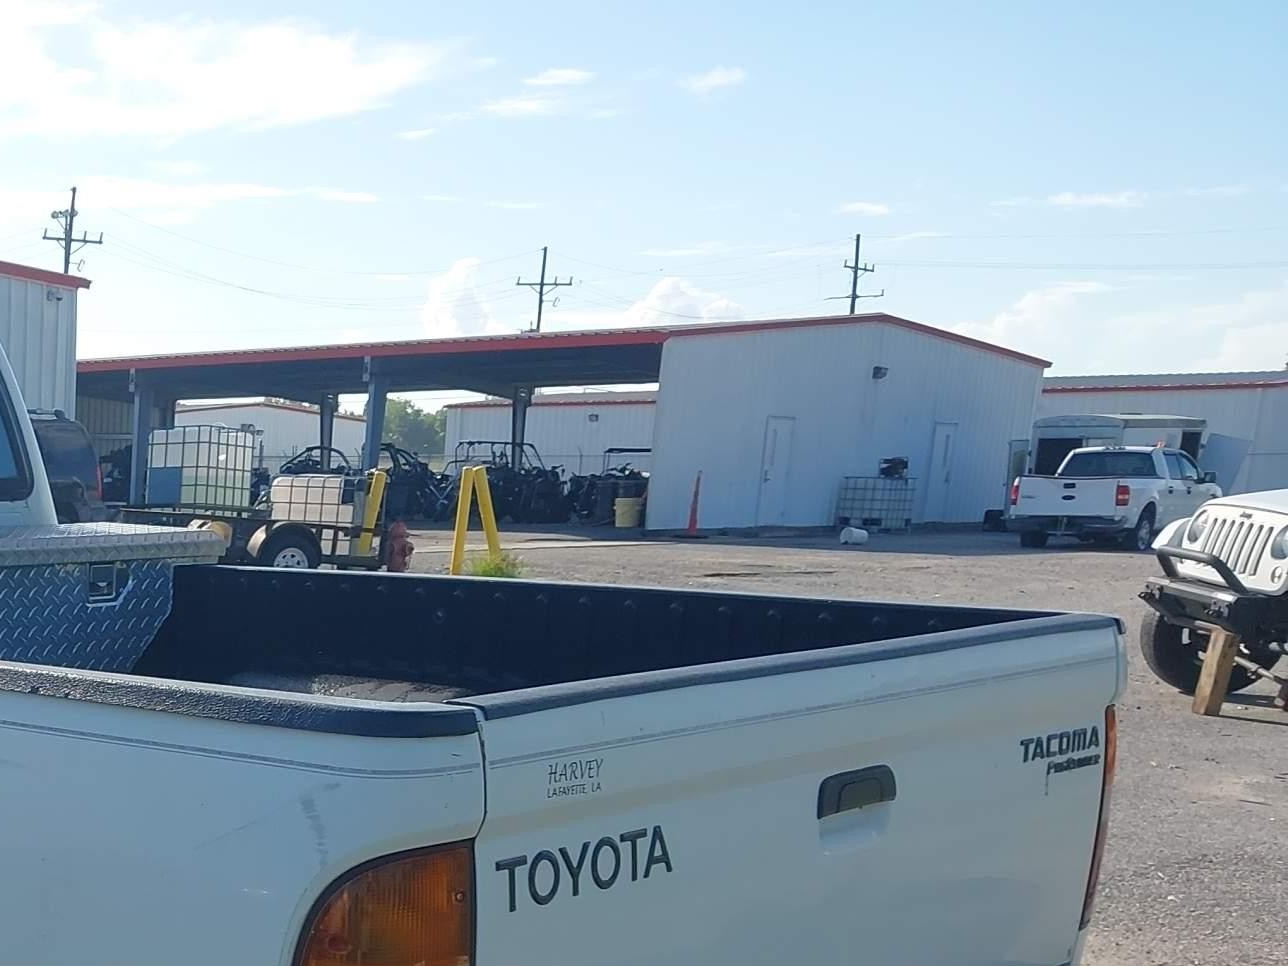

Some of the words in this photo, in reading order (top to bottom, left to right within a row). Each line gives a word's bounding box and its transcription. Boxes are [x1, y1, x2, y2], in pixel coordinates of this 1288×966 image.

[1019, 725, 1100, 763] TACOMA
[547, 758, 604, 785] HARVEY
[592, 782, 602, 793] LA
[494, 824, 673, 913] TOYOTA
